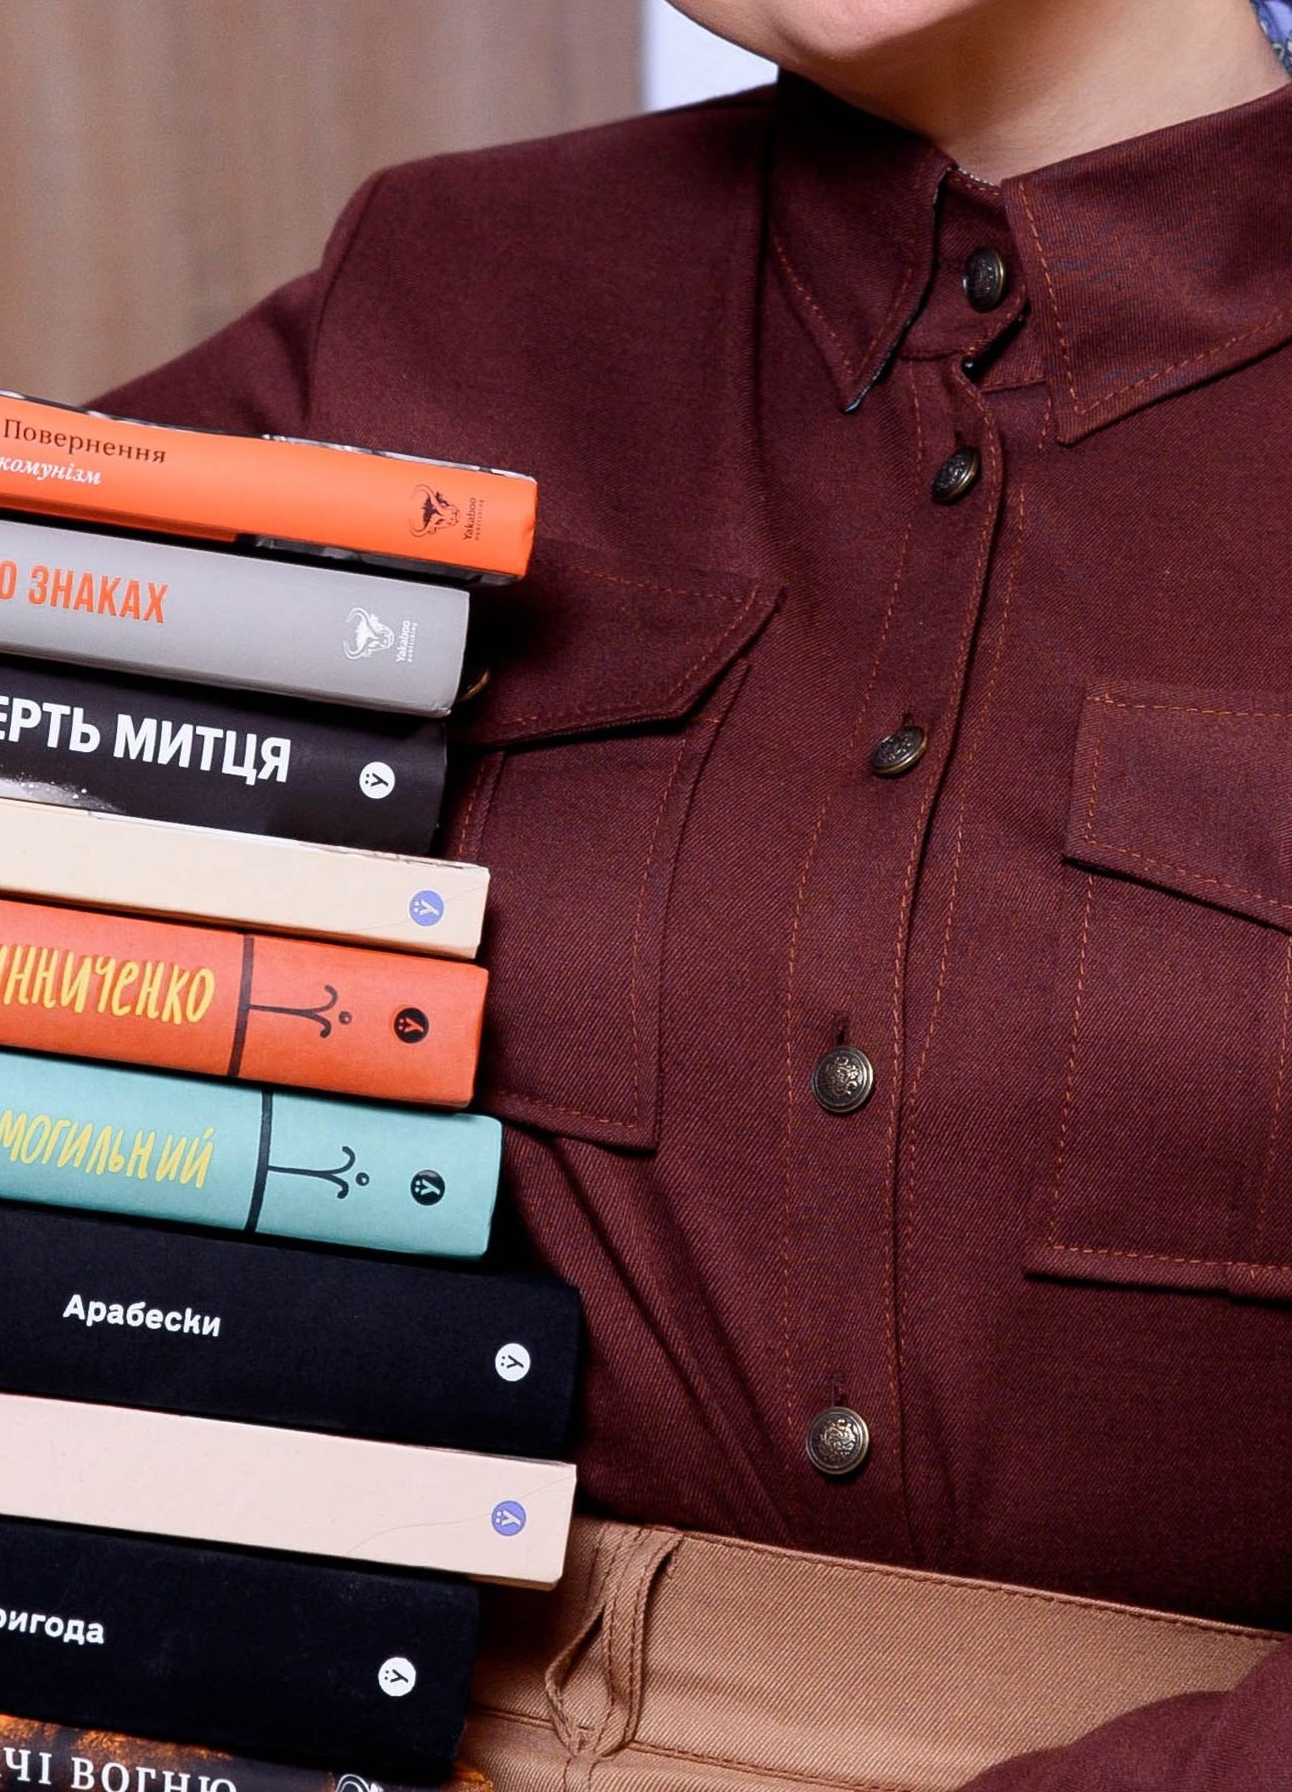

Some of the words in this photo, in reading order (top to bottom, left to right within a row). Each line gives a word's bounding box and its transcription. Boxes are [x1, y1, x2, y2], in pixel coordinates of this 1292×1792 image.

[3, 419, 166, 464] Повернення
[28, 564, 168, 623] ЗНАКАХ
[113, 713, 291, 785] МИТЦЯ
[62, 1294, 221, 1337] Арабески
